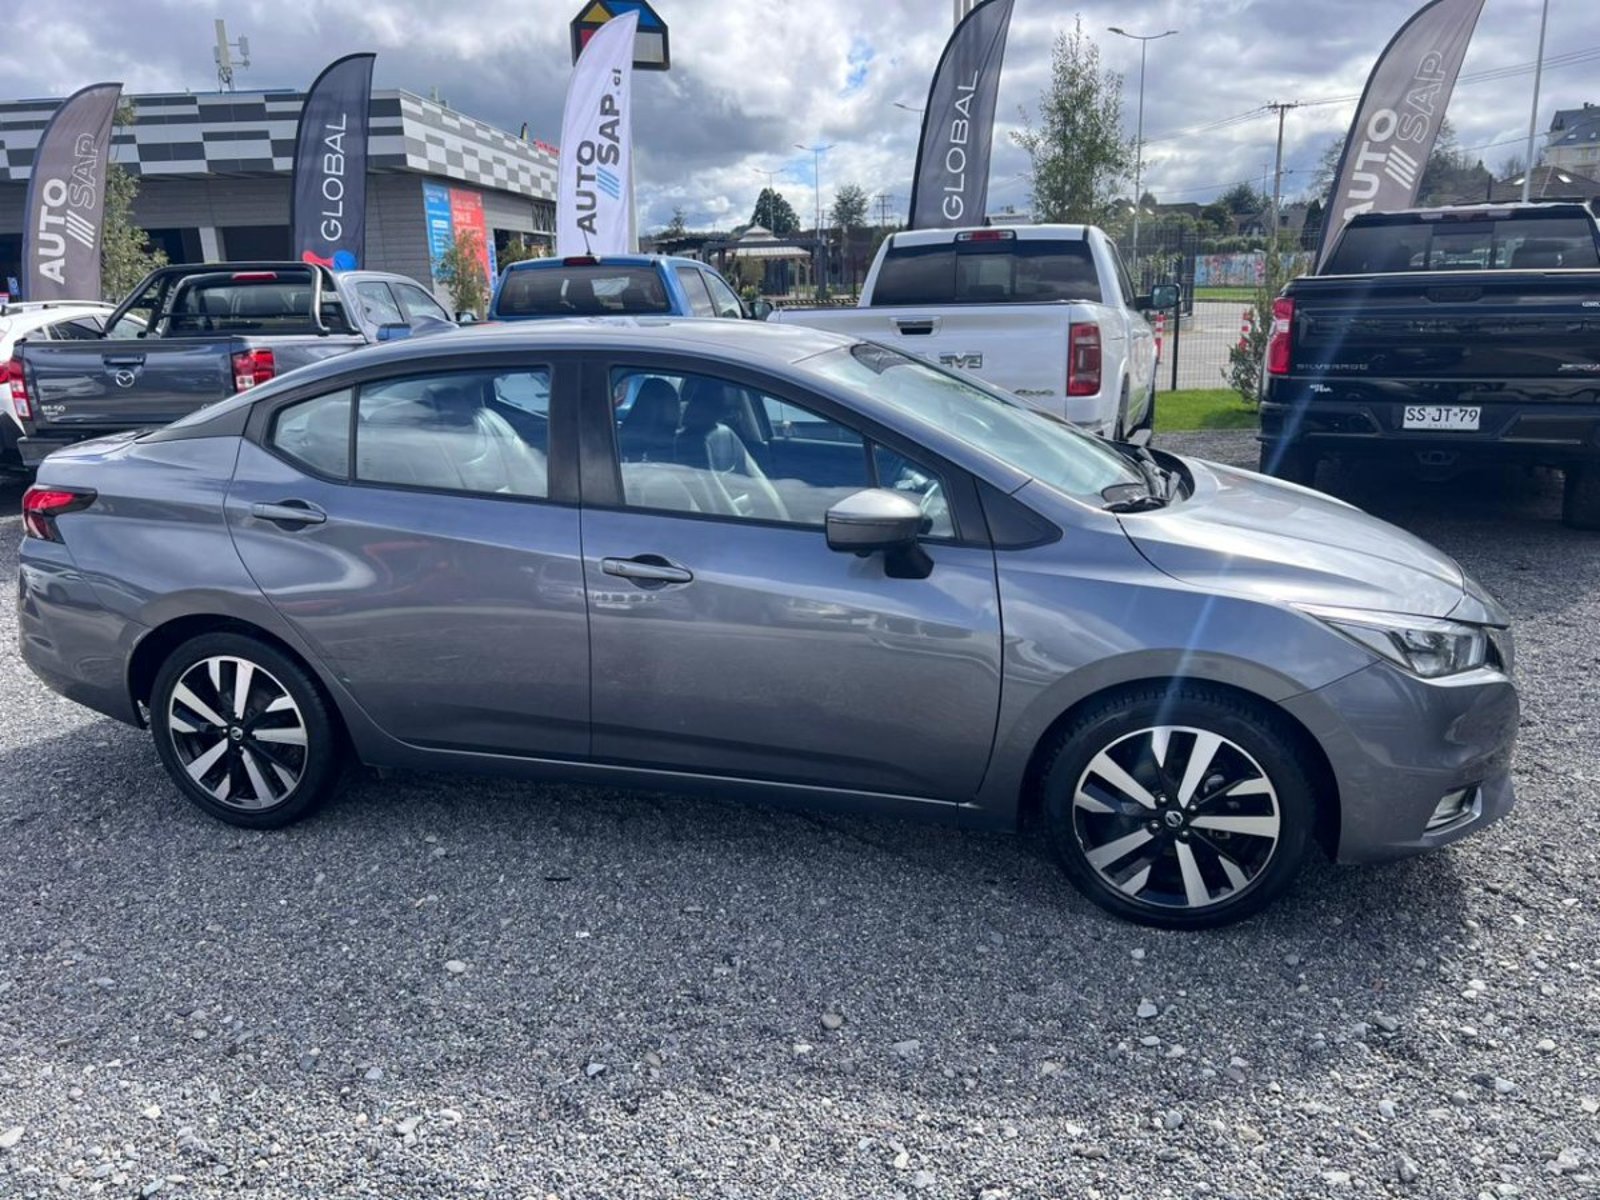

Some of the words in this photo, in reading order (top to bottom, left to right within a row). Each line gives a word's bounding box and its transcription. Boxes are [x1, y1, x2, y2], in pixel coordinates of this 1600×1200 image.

[943, 70, 978, 220] GLOBAL
[1395, 50, 1446, 143] SAP
[67, 132, 98, 210] SAP
[320, 113, 347, 241] GLOBAL
[576, 140, 597, 235] AUTO
[38, 178, 67, 285] AUTO
